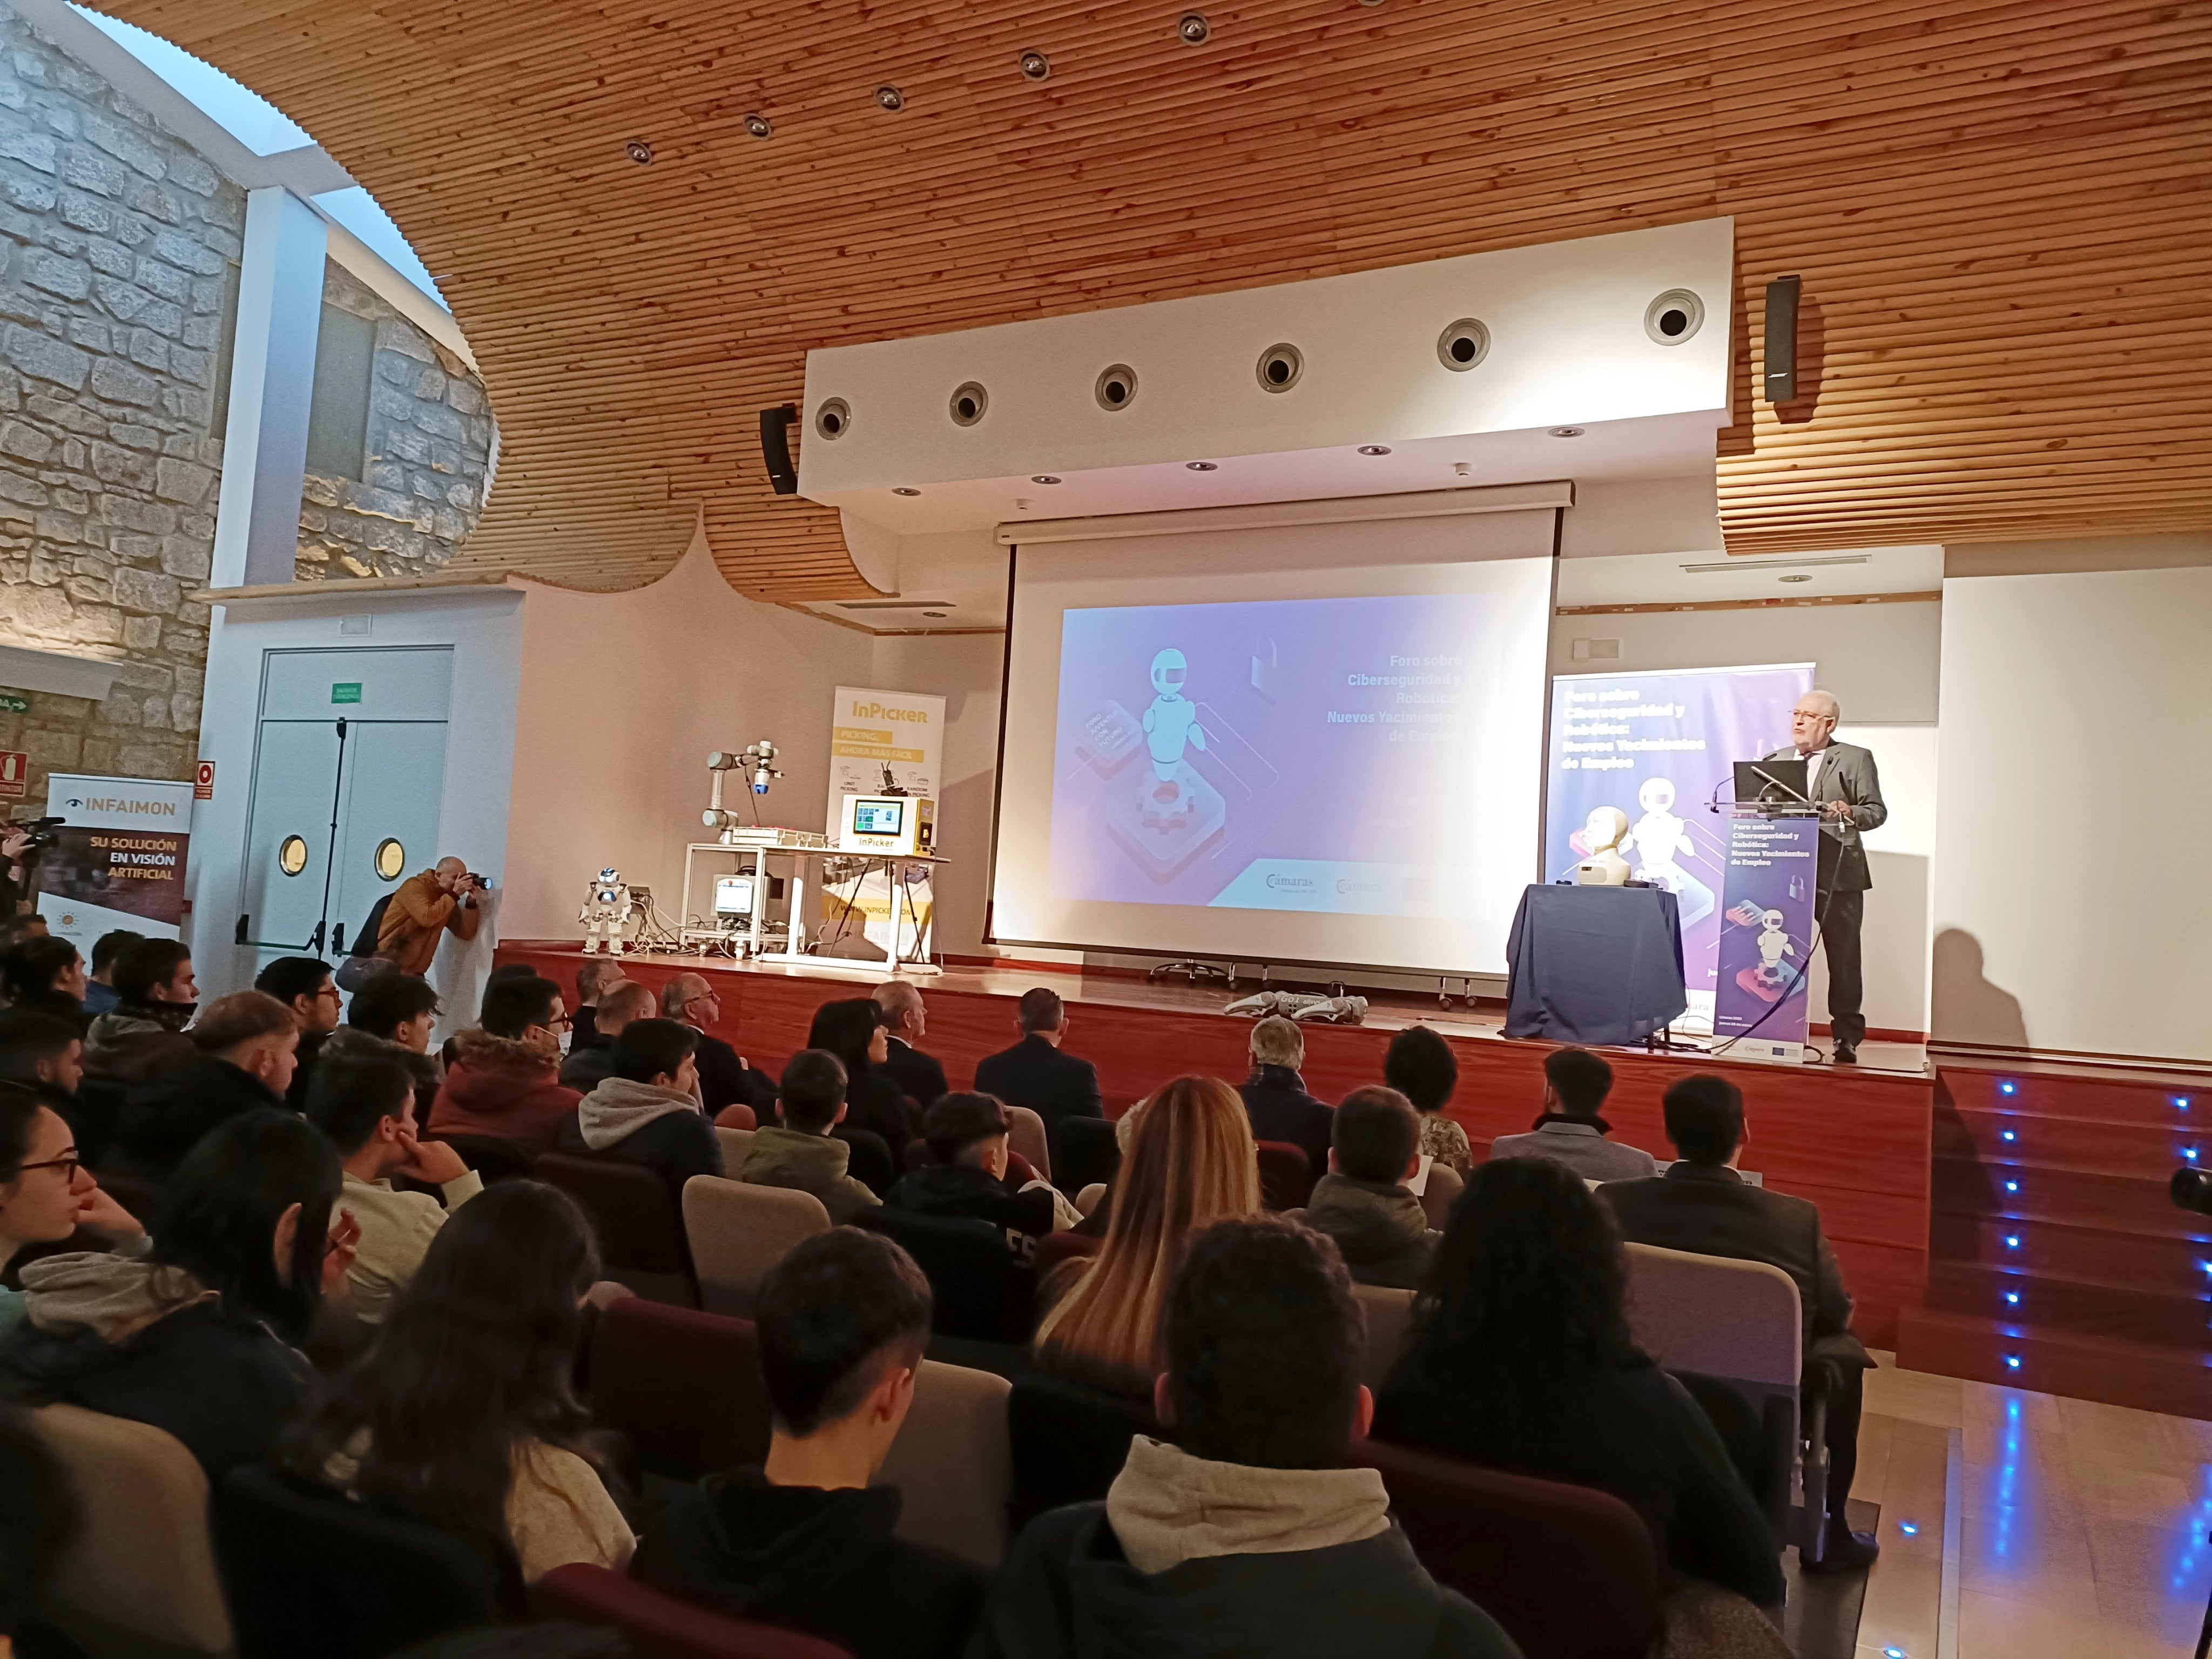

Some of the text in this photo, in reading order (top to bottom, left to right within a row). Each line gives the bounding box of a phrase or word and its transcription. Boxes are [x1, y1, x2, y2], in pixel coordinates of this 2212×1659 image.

[1390, 653, 1462, 666] Foro sobre
[1347, 673, 1451, 688] Ciberseguridad
[1327, 711, 1375, 723] Nuevos
[1675, 705, 1685, 718] y
[841, 730, 879, 742] PICKING,
[1388, 730, 1404, 742] de
[840, 746, 871, 756] AHORA
[86, 798, 175, 816] INFAIMON
[1732, 832, 1793, 840] Ciberseguridad
[90, 837, 177, 851] SU SOLUCIÓN
[110, 852, 175, 866] EN VISIÓN
[108, 867, 173, 880] ARTIFICIAL
